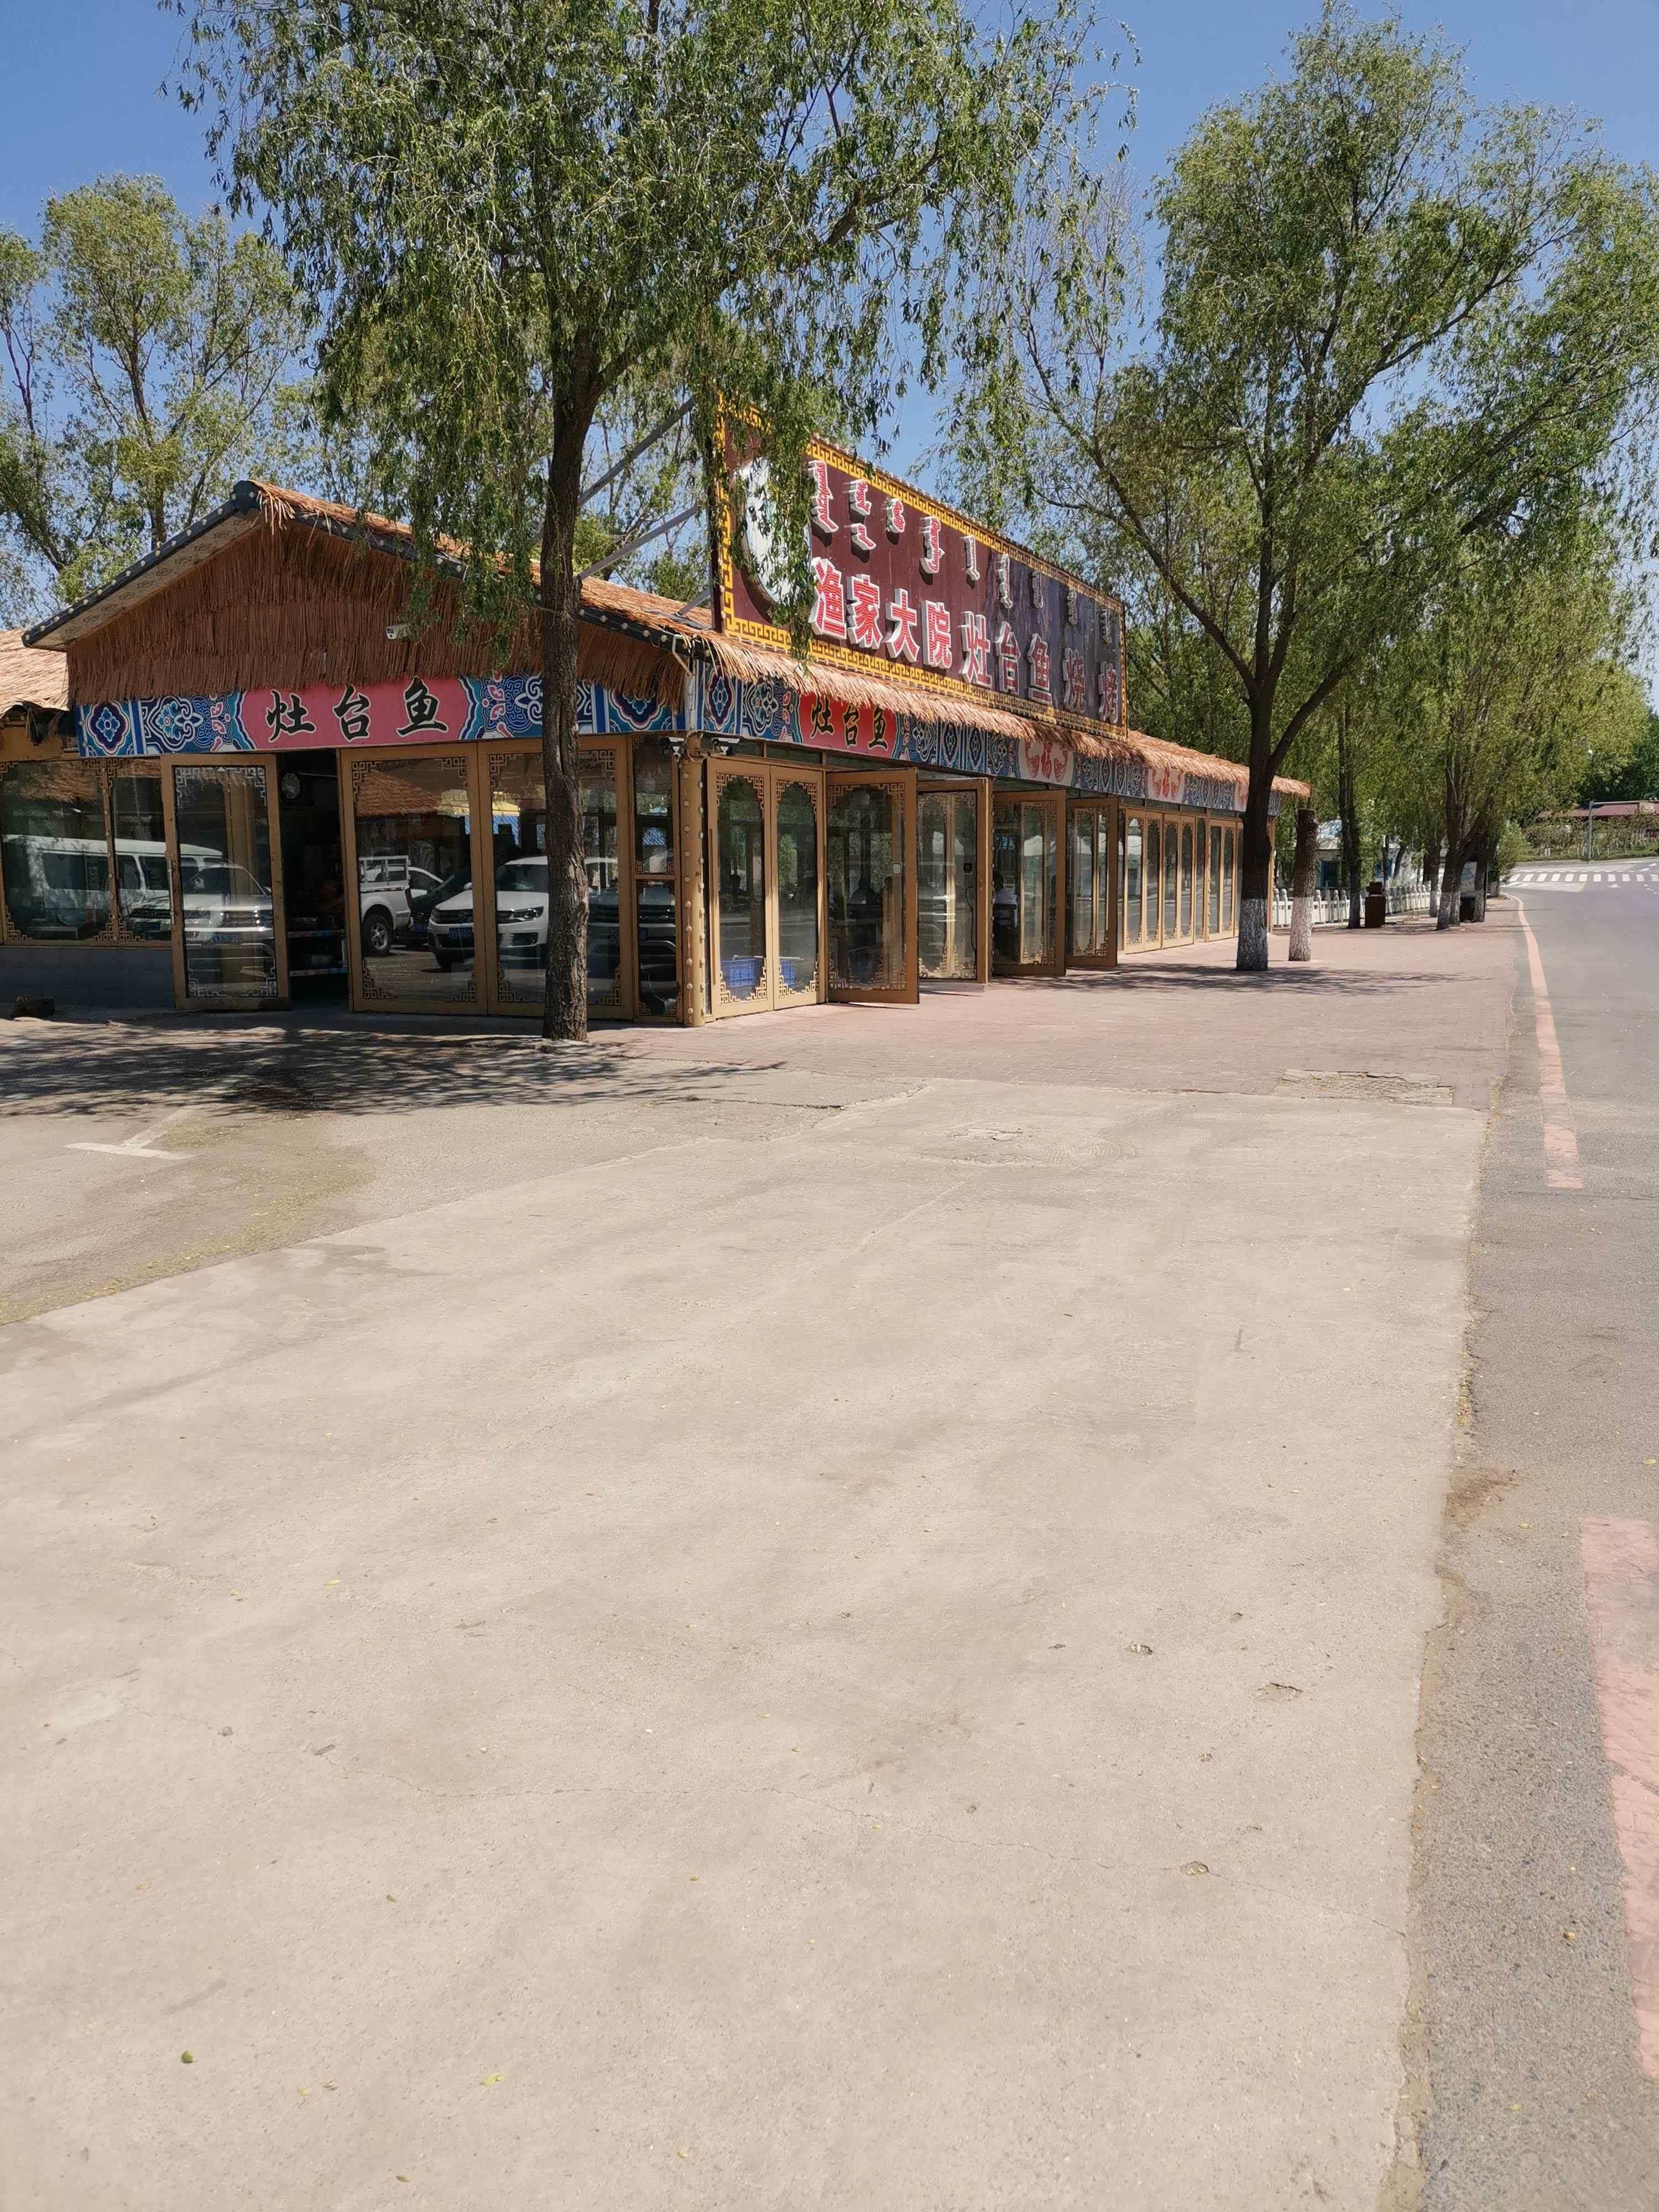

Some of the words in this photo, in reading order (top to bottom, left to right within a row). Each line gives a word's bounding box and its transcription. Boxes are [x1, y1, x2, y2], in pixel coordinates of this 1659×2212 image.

[265, 676, 448, 743] 灶台鱼
[810, 694, 888, 751] 灶台鱼
